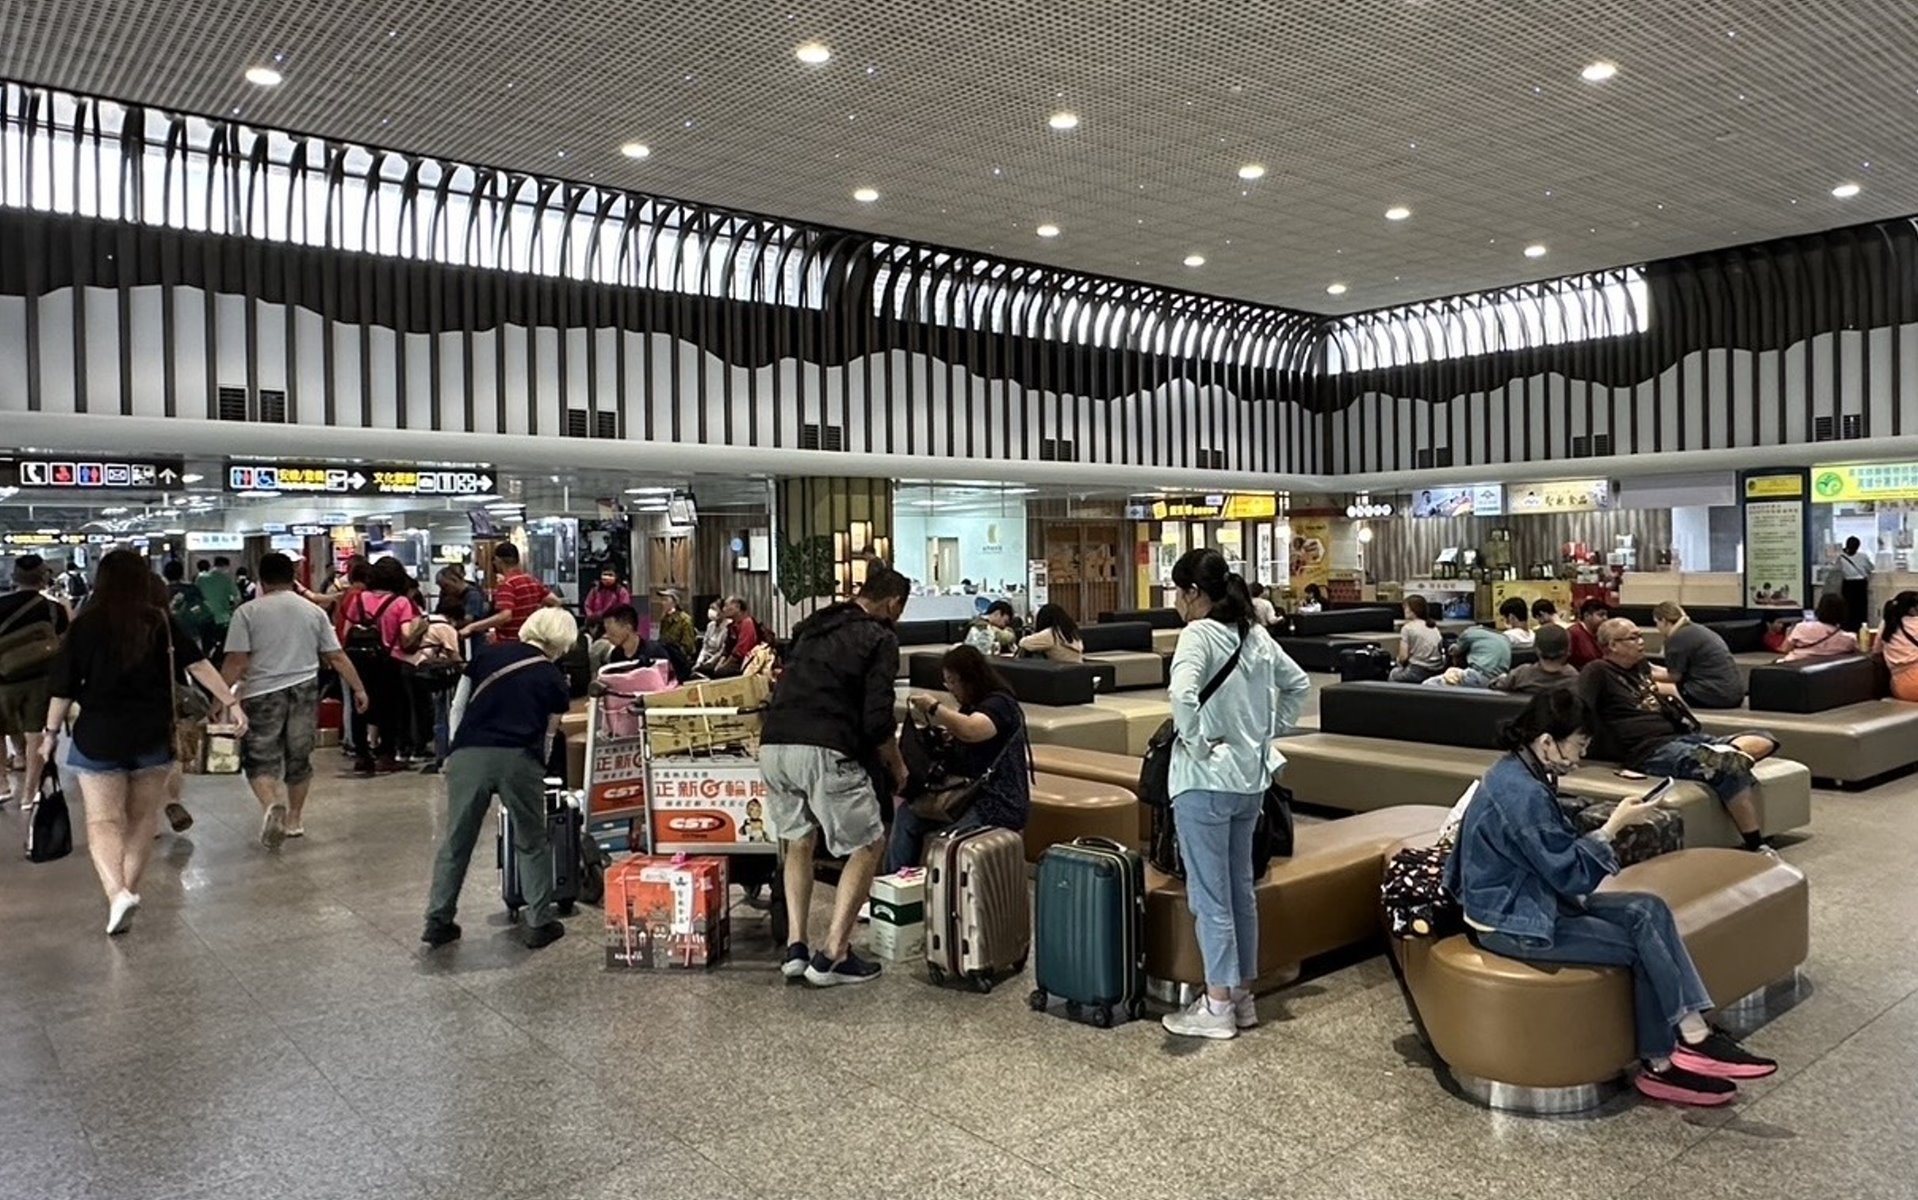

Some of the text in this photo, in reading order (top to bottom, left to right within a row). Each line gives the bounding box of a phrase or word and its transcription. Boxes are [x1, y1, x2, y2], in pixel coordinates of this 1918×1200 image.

[596, 752, 633, 771] 正新
[604, 786, 640, 799] CST
[669, 817, 716, 832] CST
